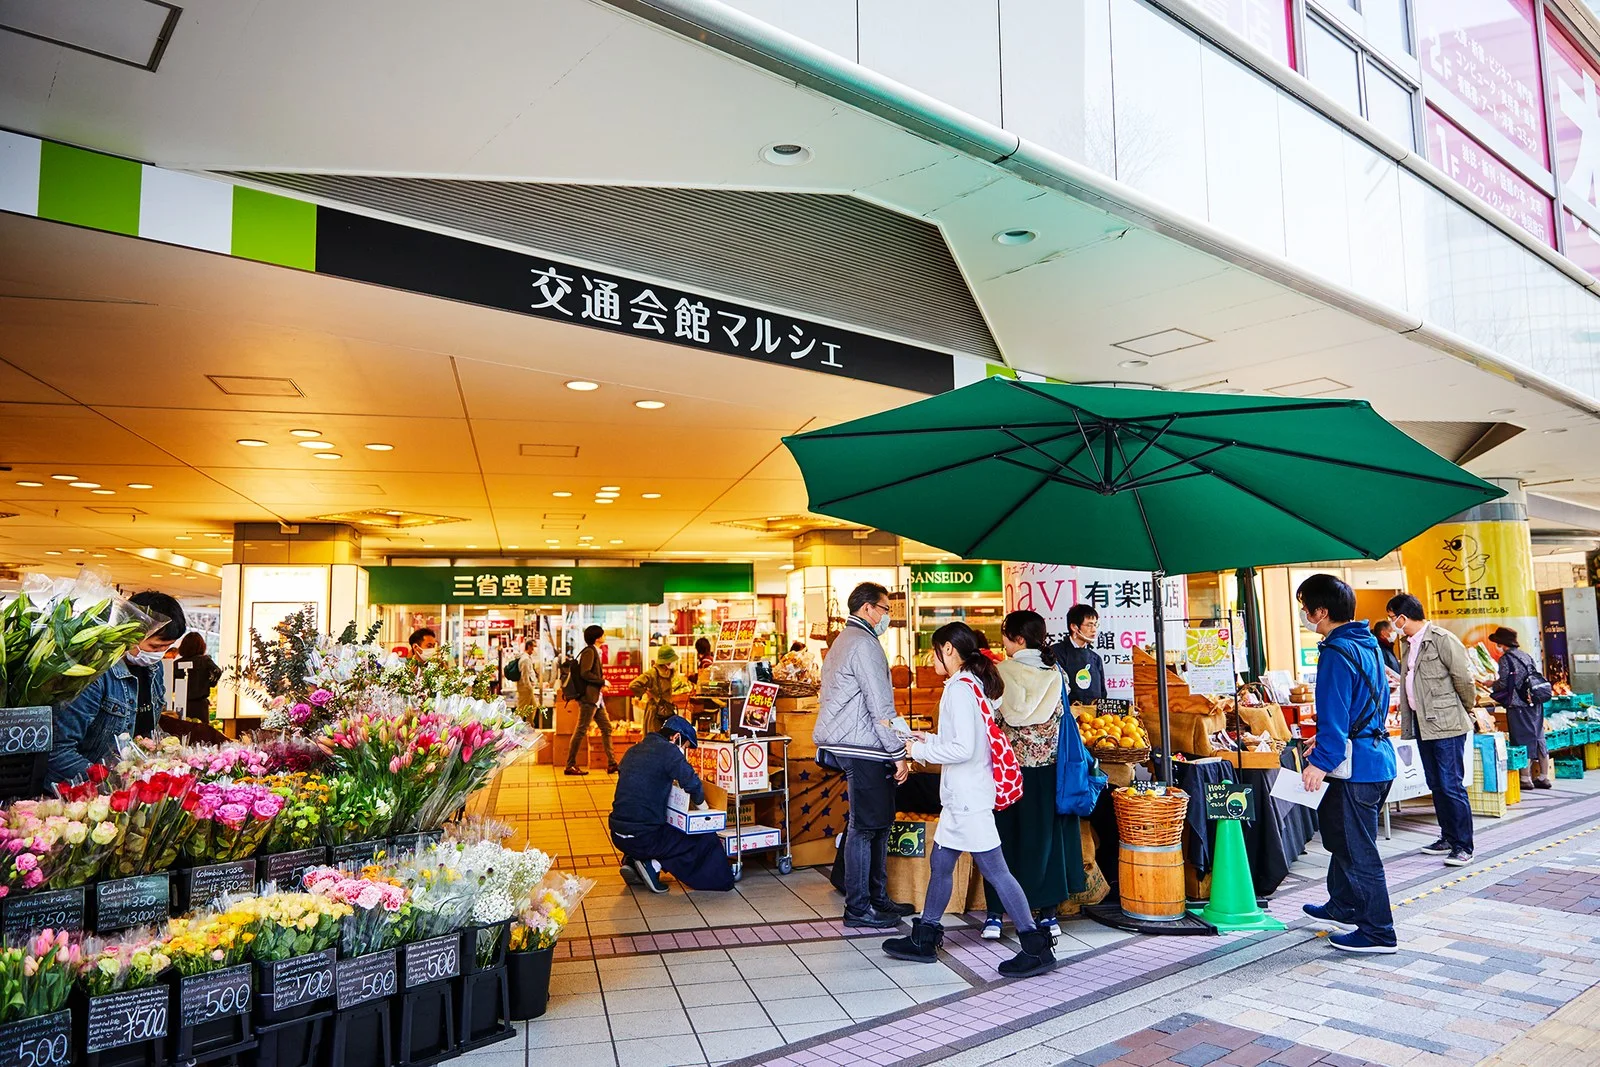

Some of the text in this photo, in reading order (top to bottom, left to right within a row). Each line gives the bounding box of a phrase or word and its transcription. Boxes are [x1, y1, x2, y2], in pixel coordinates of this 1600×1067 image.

[1436, 123, 1460, 179] 1F
[530, 266, 844, 369] 交通会館マルシェ
[452, 574, 573, 597] 三省堂書店
[910, 571, 974, 584] SANSEIDO
[1435, 586, 1500, 603] イセ食品
[1120, 631, 1147, 649] 6F
[1103, 654, 1134, 664] り下さ
[6, 725, 50, 752] 800
[1208, 784, 1226, 792] HOOS
[225, 866, 244, 875] rose
[50, 894, 73, 903] rose
[427, 949, 456, 979] 500
[296, 969, 333, 1000] 700
[361, 969, 395, 998] 500
[206, 983, 250, 1017] 500
[123, 1007, 167, 1042] ¥500
[19, 1033, 68, 1067] 500
